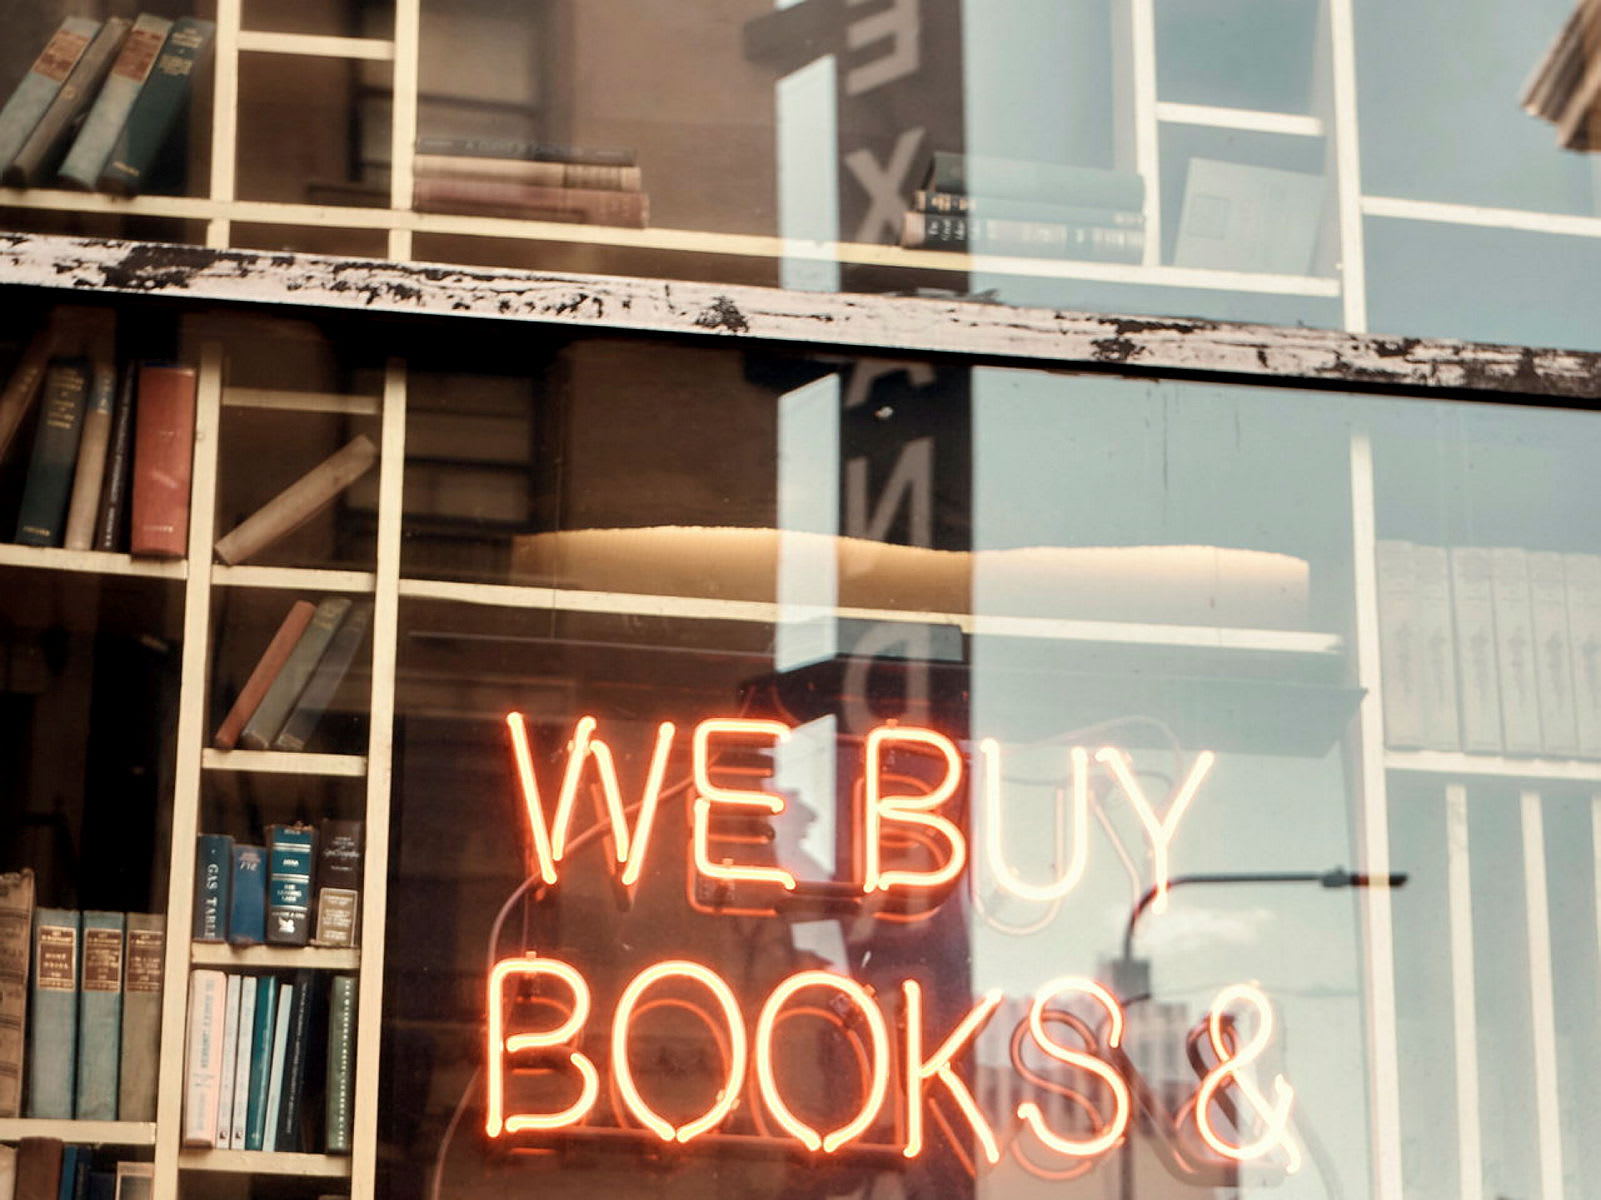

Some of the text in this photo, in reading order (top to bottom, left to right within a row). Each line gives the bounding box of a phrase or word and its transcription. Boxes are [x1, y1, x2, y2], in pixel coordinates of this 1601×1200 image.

[206, 863, 220, 890] GAS
[504, 710, 1215, 914] WE BUY
[484, 956, 1131, 1164] BOOKS
[1194, 982, 1301, 1172] &
